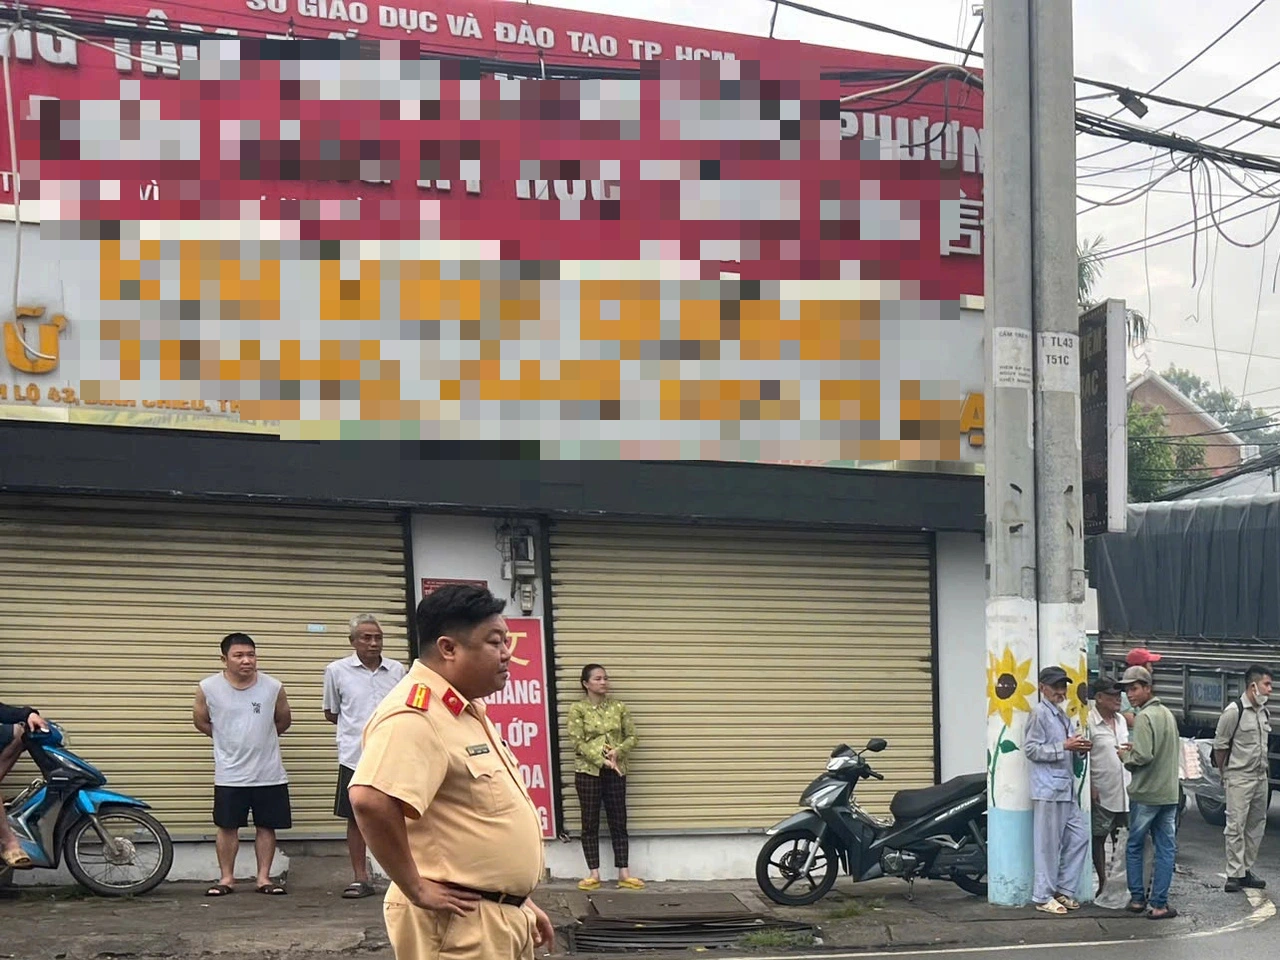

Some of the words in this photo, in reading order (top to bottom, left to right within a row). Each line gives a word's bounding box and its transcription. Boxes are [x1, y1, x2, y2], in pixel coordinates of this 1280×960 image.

[378, 5, 438, 34] DỤC
[446, 12, 483, 39] VÀ
[493, 19, 555, 48] ĐÀO
[566, 30, 619, 58] TẠO
